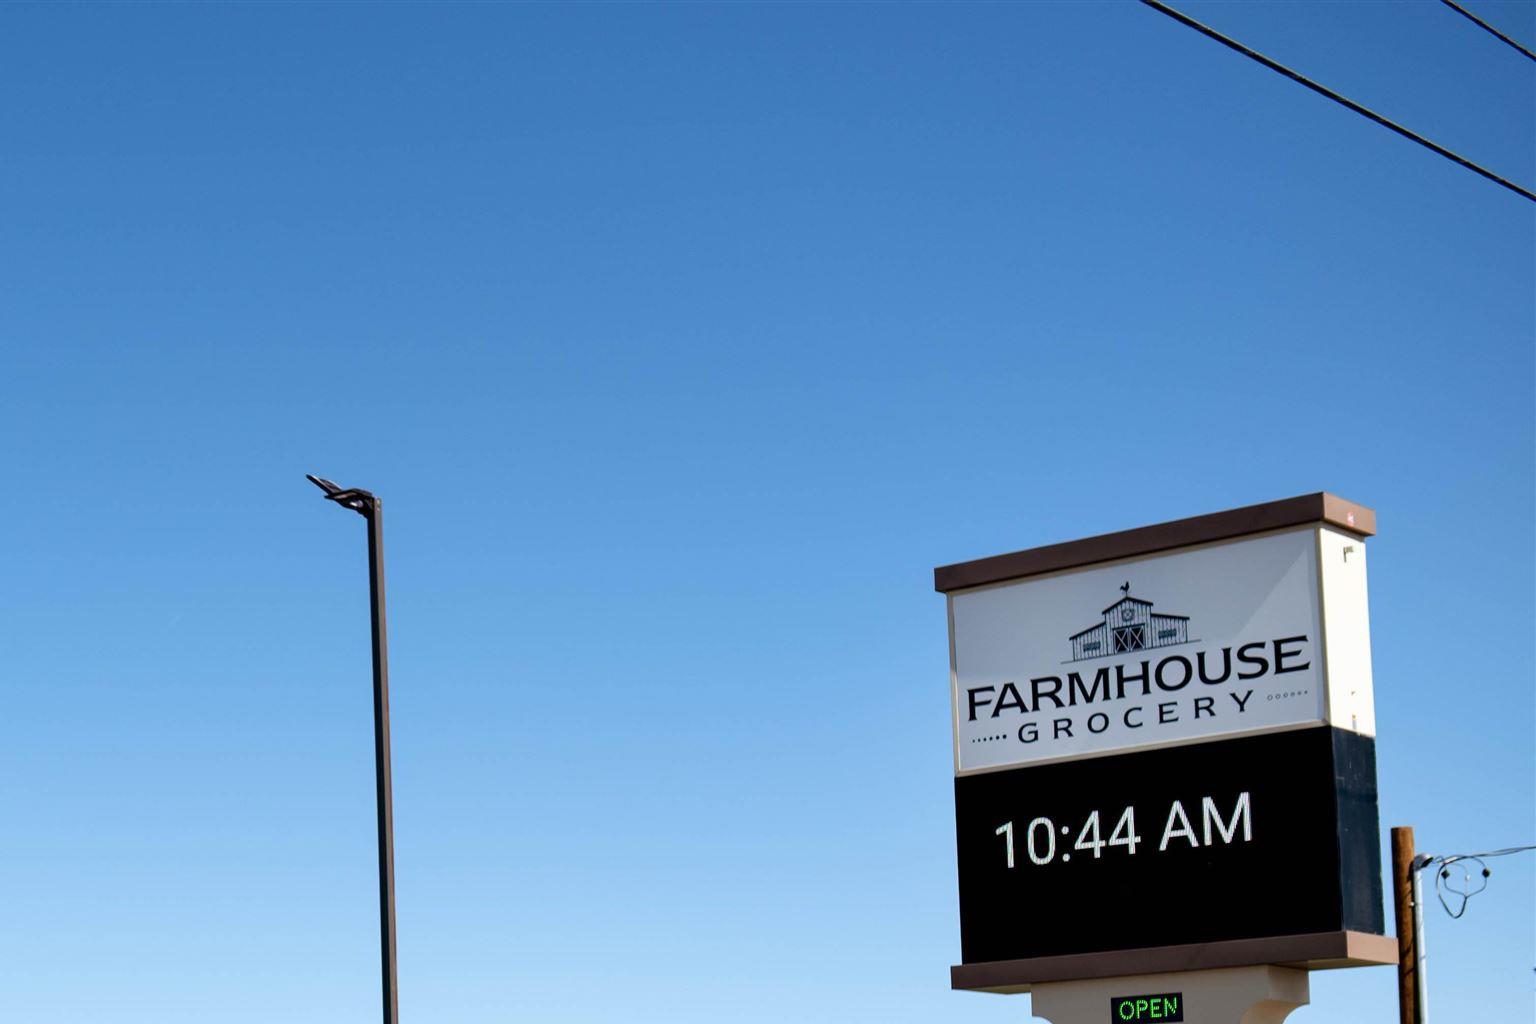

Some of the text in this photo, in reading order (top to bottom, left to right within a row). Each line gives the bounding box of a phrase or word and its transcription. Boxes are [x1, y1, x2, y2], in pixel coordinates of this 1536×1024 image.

[966, 634, 1312, 722] FARMHOUSE
[1017, 690, 1254, 744] GROCERY
[995, 791, 1253, 868] 10:44 AM
[1119, 997, 1177, 1020] OPEN
